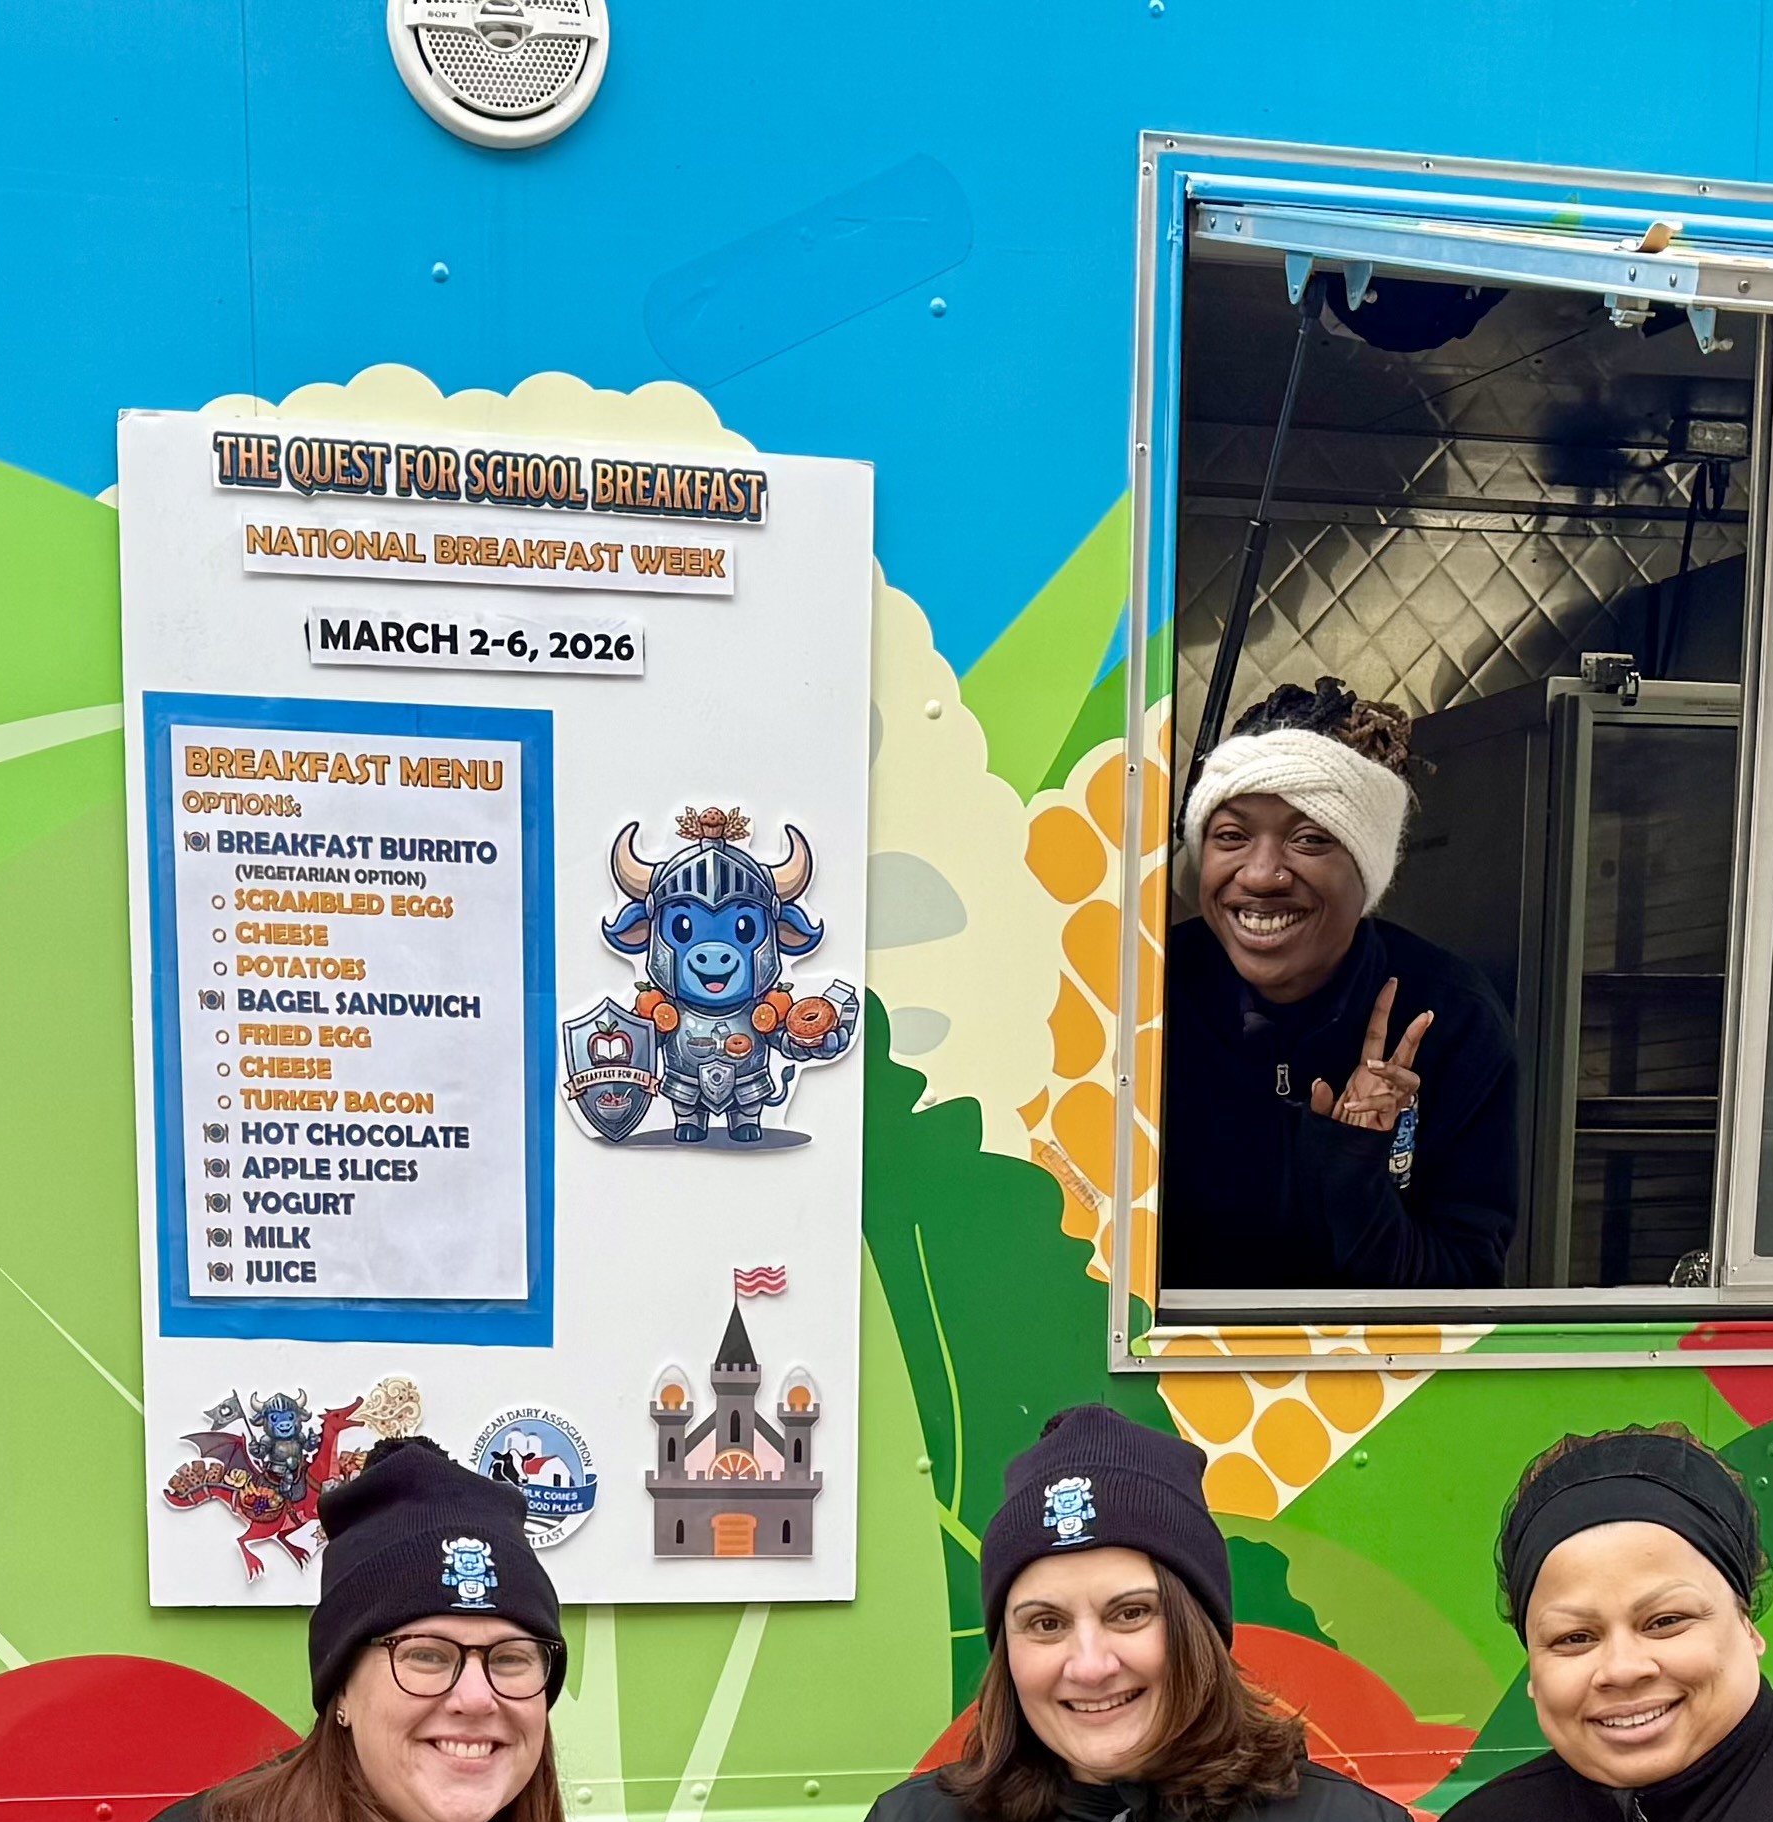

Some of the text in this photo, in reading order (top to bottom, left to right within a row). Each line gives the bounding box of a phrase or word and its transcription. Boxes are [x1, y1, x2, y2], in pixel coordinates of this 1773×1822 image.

[215, 432, 767, 521] THE QUEST FOR SCHOOL BREAKFAST
[245, 524, 727, 579] NATIONAL BREAKFAST WEEK
[320, 619, 636, 663] MARCH 2-6, 2026
[184, 745, 504, 791] BREAKFAST MENU
[182, 790, 303, 818] OPTIONS:
[217, 830, 497, 865] BREAKFAST BURRITO
[235, 864, 427, 889] (VEGETARIAN OPTION)
[235, 889, 454, 919] SCRAMBLED EGGS
[235, 921, 329, 947] CHEESE
[236, 955, 367, 981] POTATOES
[237, 989, 481, 1018] BAGEL SANDWICH
[238, 1023, 372, 1048] FRIED EGG
[239, 1056, 333, 1080] CHEESE
[240, 1088, 435, 1115] TURKEY BACON
[241, 1122, 471, 1149] HOT CHOCOLATE
[242, 1156, 418, 1183] APPLE SLICES
[243, 1191, 356, 1216] YOGURT
[244, 1226, 312, 1250] MILK
[245, 1260, 317, 1285] JUICE
[468, 1408, 593, 1467] AMERICAN DAIRY ASSOCIATION
[527, 1501, 584, 1512] OOD PLACE
[543, 1491, 578, 1501] COMES
